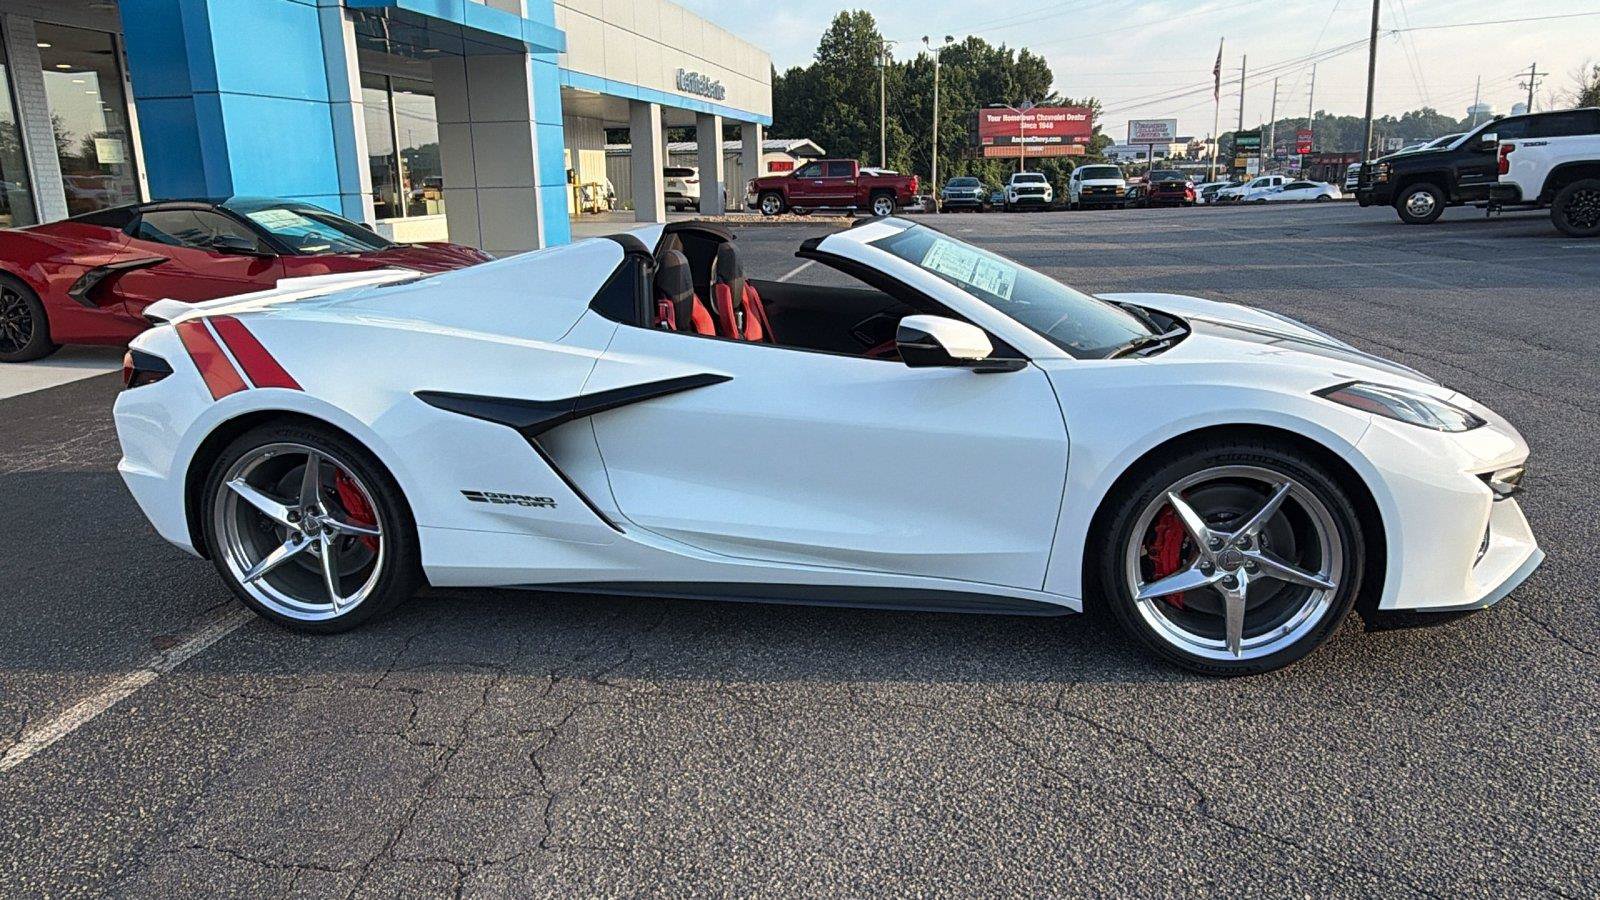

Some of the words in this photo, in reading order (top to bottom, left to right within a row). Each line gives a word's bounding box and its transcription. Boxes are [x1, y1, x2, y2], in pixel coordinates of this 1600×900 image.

[987, 114, 1001, 122] Your
[1036, 113, 1065, 121] Chevrolet
[483, 492, 555, 502] GRAND
[489, 499, 557, 508] SPORT
